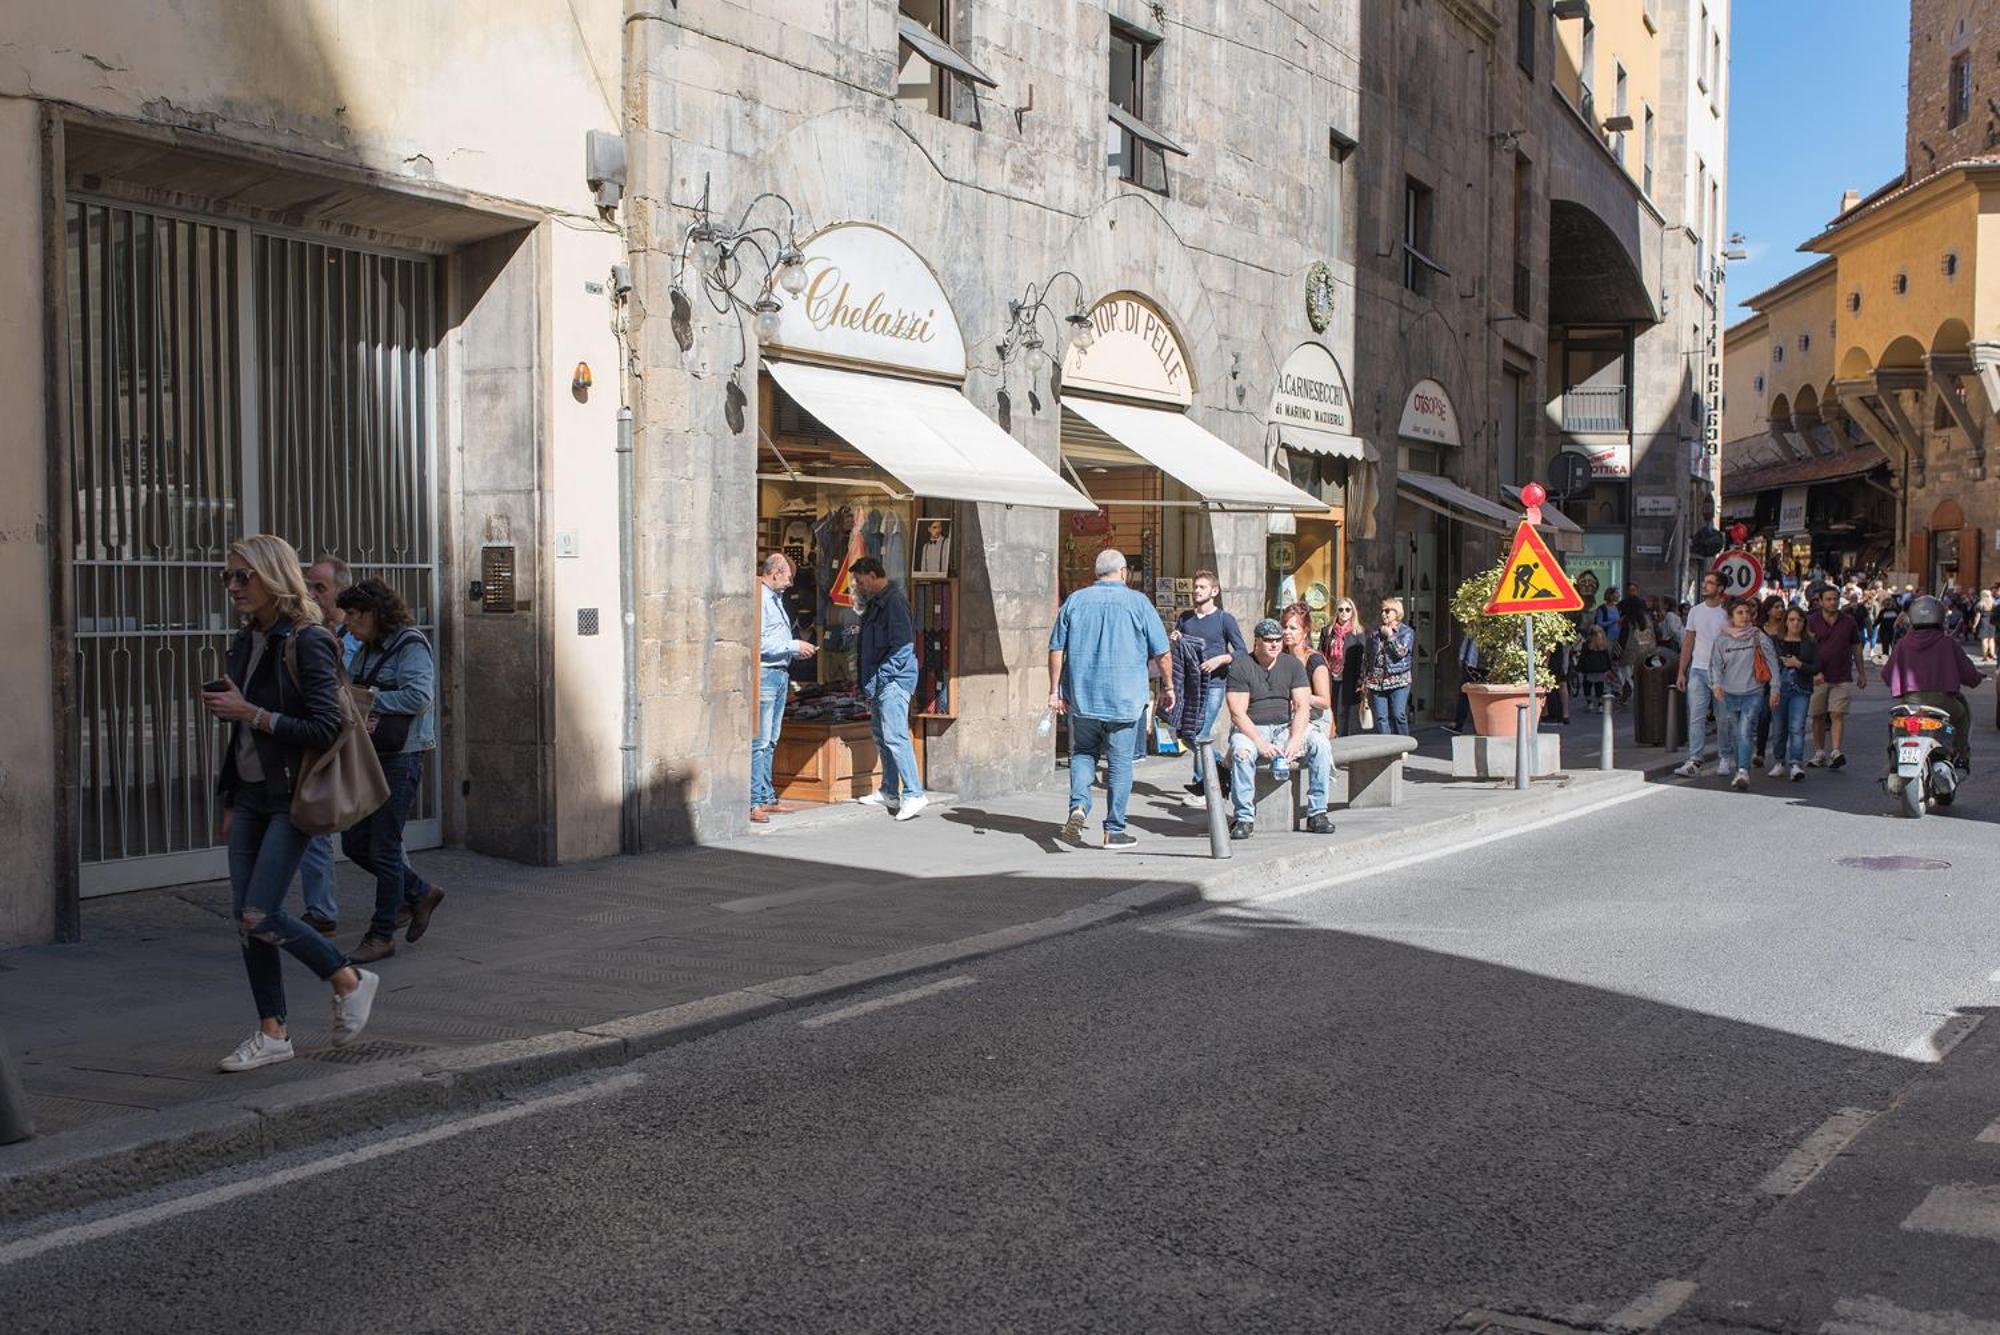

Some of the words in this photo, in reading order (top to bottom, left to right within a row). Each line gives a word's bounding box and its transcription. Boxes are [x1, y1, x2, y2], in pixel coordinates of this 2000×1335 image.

[801, 256, 936, 344] Chelazzi
[1125, 301, 1140, 334] DI
[1143, 313, 1183, 385] PELLE
[1275, 401, 1282, 415] di
[1285, 403, 1312, 420] MARINO
[1592, 465, 1627, 474] OTTICA
[1722, 564, 1751, 588] 30
